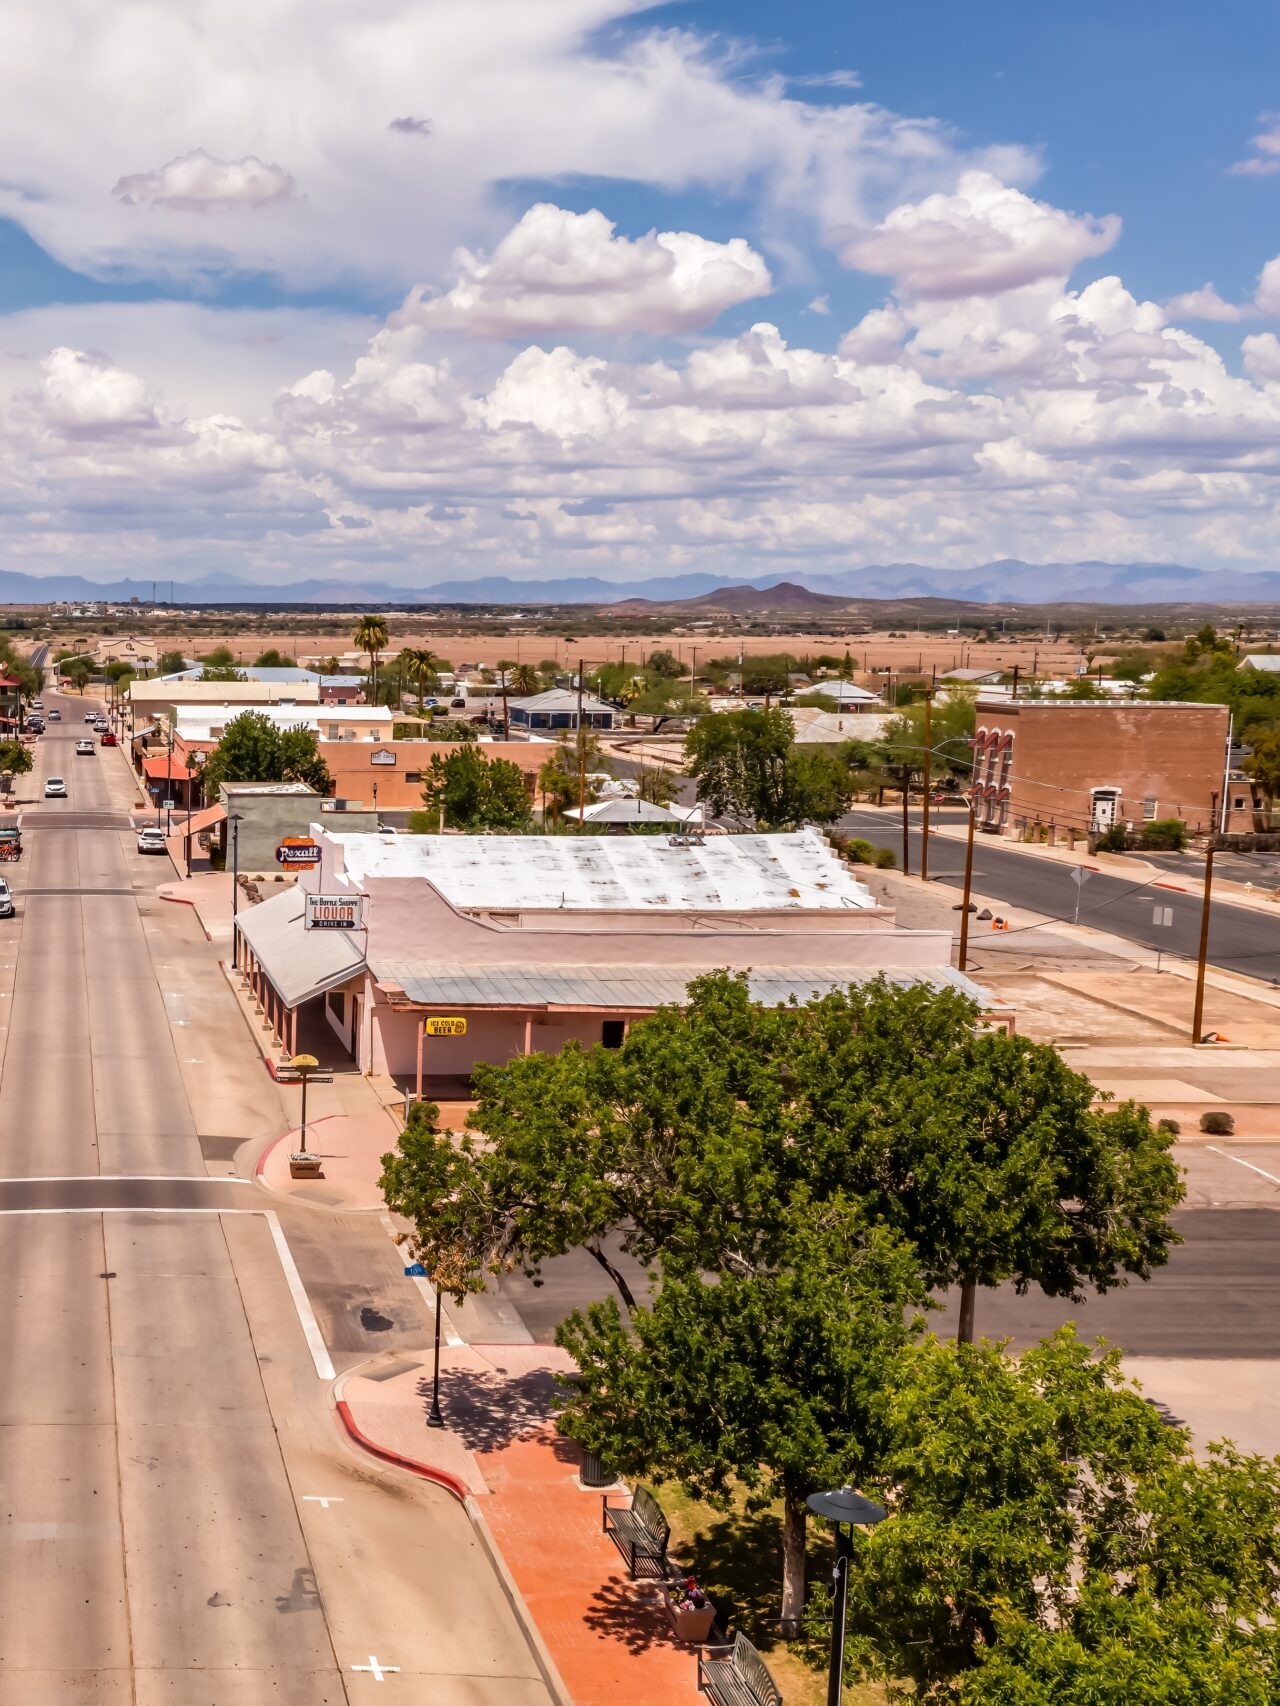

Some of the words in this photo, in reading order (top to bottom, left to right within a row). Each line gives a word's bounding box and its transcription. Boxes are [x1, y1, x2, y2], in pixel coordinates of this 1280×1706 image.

[280, 847, 318, 861] Rexall
[309, 897, 318, 905] THE
[320, 897, 337, 906] BOTTLE
[339, 898, 358, 906] SHOPPE
[314, 906, 353, 919] LIQUOR
